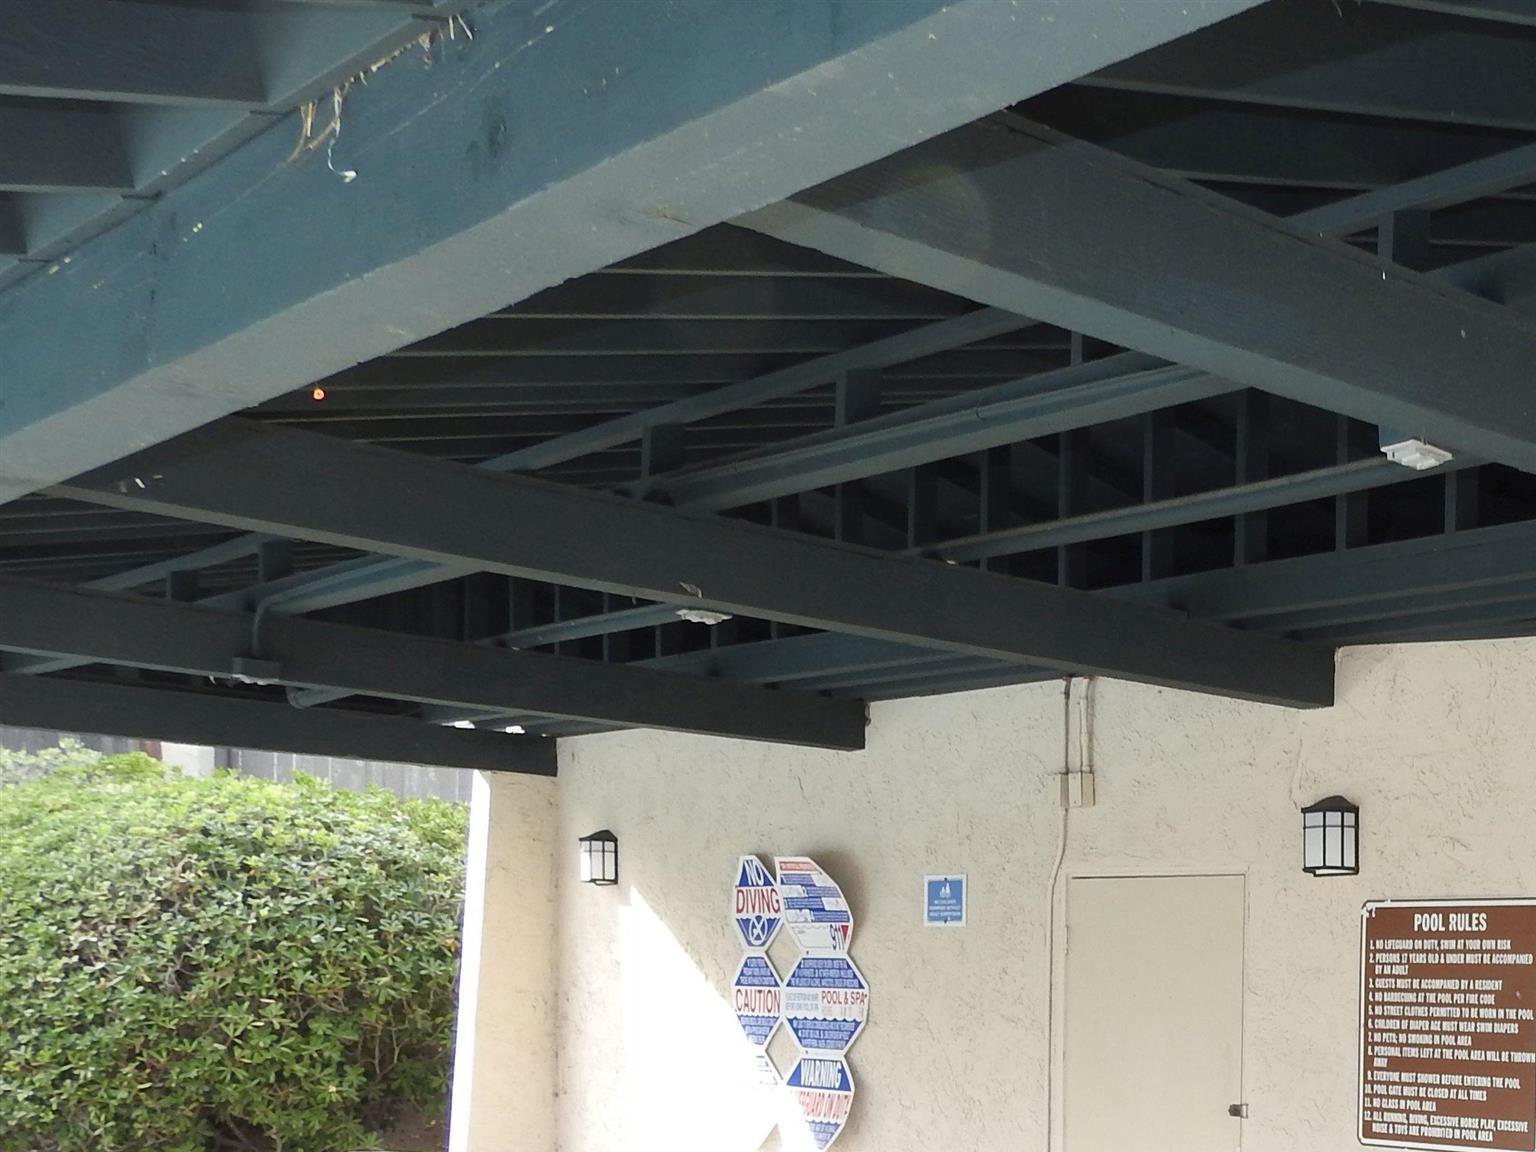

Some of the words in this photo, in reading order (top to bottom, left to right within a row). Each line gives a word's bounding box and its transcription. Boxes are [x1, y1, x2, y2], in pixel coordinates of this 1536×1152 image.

[744, 859, 765, 886] NO
[736, 888, 781, 914] DIVING
[1414, 913, 1446, 932] POOL
[1448, 912, 1488, 932] RULES
[735, 989, 780, 1013] CAUTION
[821, 990, 842, 1005] POOL
[844, 992, 849, 1005] &
[800, 1059, 842, 1089] WARNING
